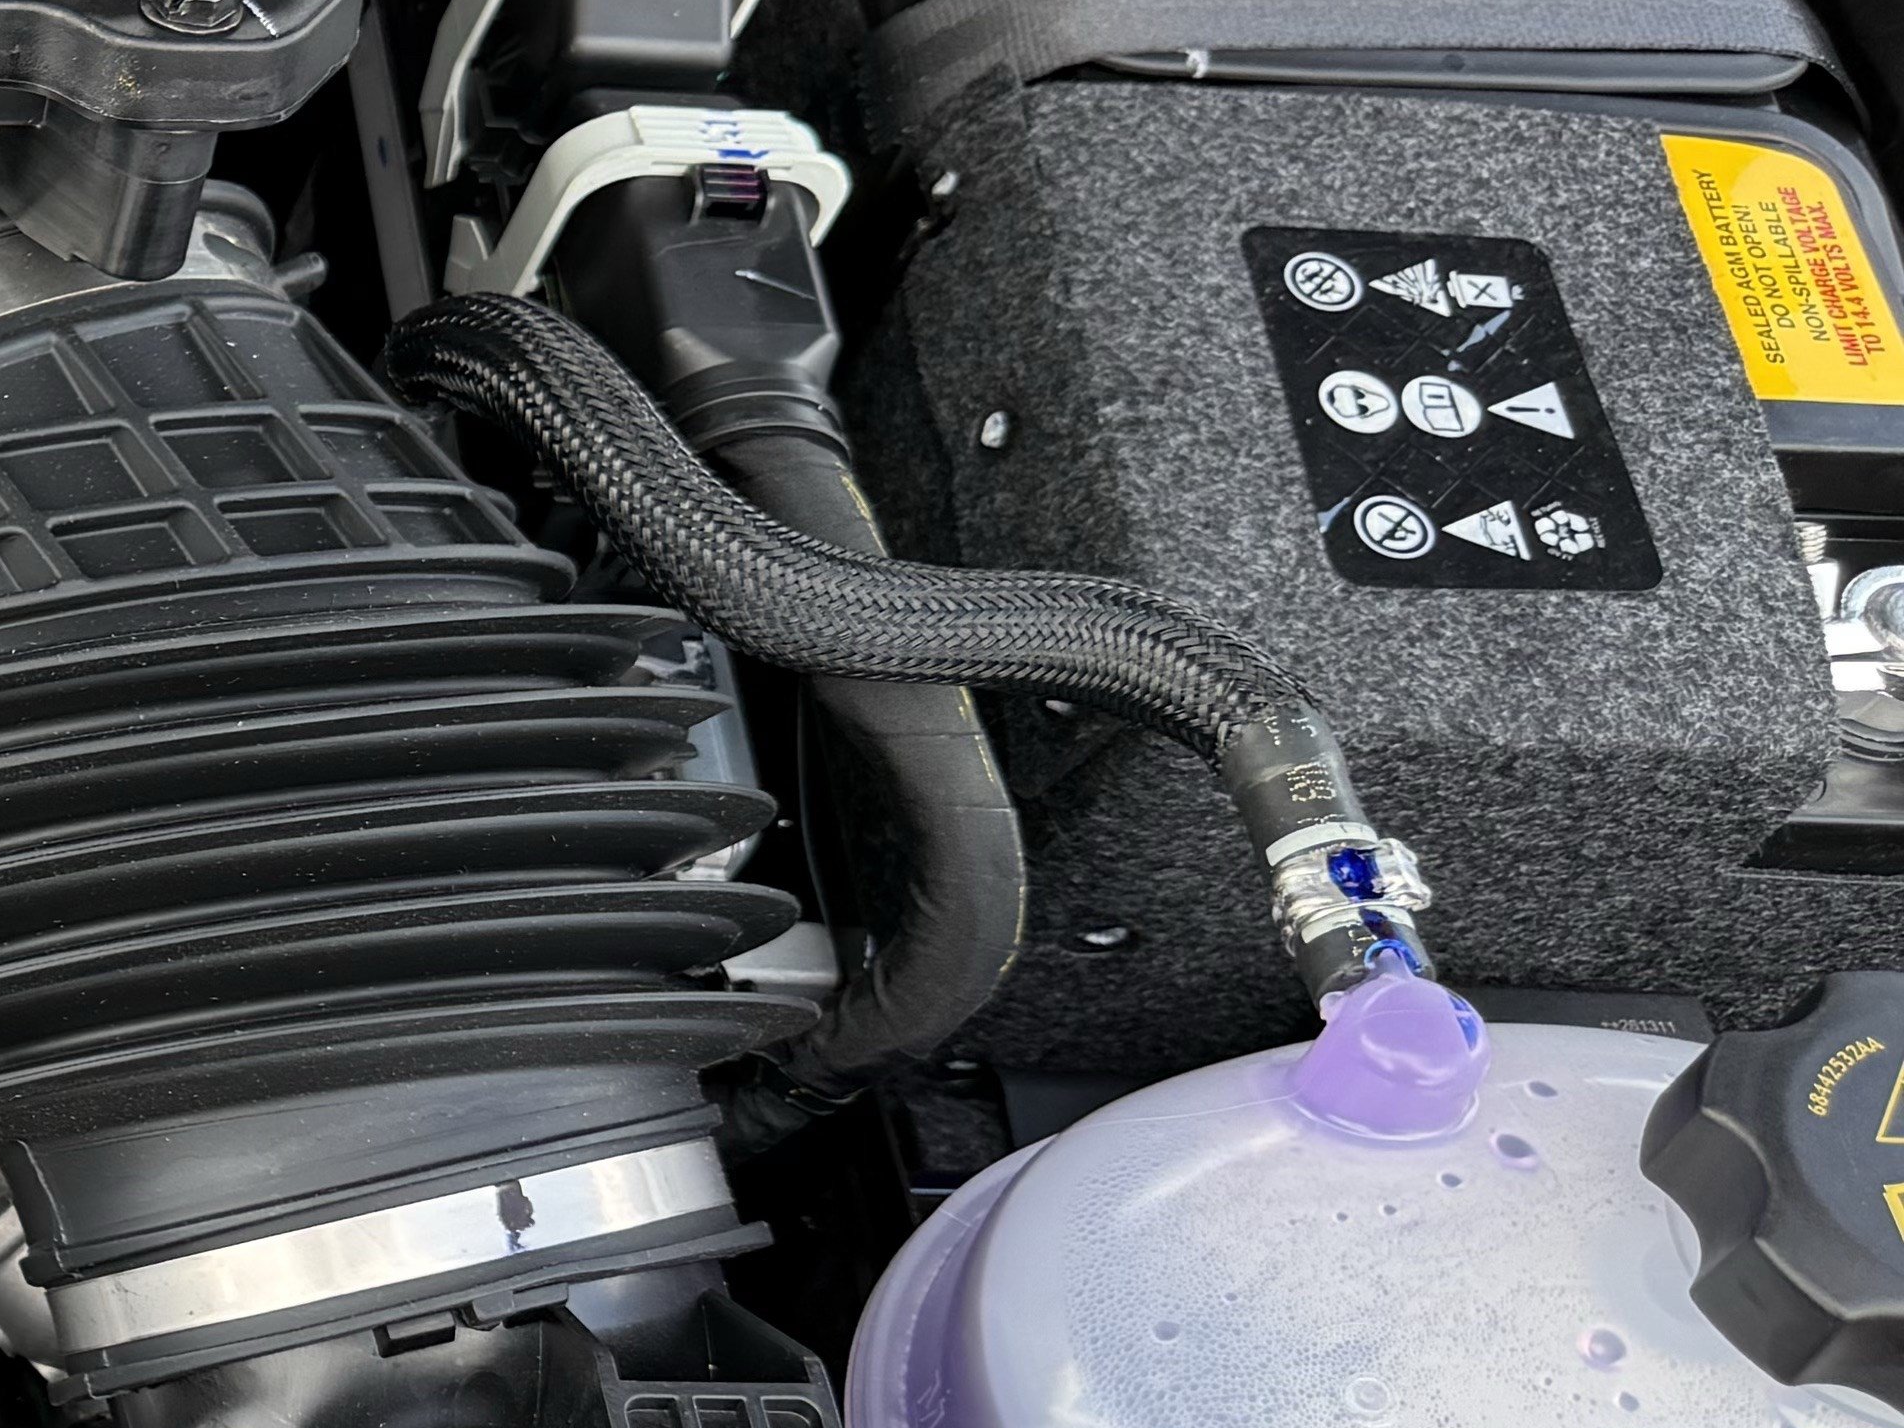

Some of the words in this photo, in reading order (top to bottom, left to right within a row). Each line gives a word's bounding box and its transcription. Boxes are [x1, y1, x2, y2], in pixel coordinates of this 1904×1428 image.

[1691, 169, 1739, 245] BATTERY
[1730, 204, 1768, 258] OPEN!
[1776, 186, 1821, 253] VOLTAGE
[1804, 201, 1838, 239] MAX.
[1723, 251, 1755, 290] AGM
[1753, 264, 1783, 298] NOT
[1757, 201, 1831, 341] NON-SPILLABLE
[1805, 258, 1848, 318] CHARGE
[1822, 243, 1860, 292] VOLTS
[1740, 294, 1785, 363] SEALED
[1768, 303, 1796, 328] DO
[1845, 296, 1875, 328] 14.4
[1832, 323, 1868, 366] LIMIT
[1861, 334, 1887, 354] TO
[1806, 1035, 1886, 1117] 68442532AA
